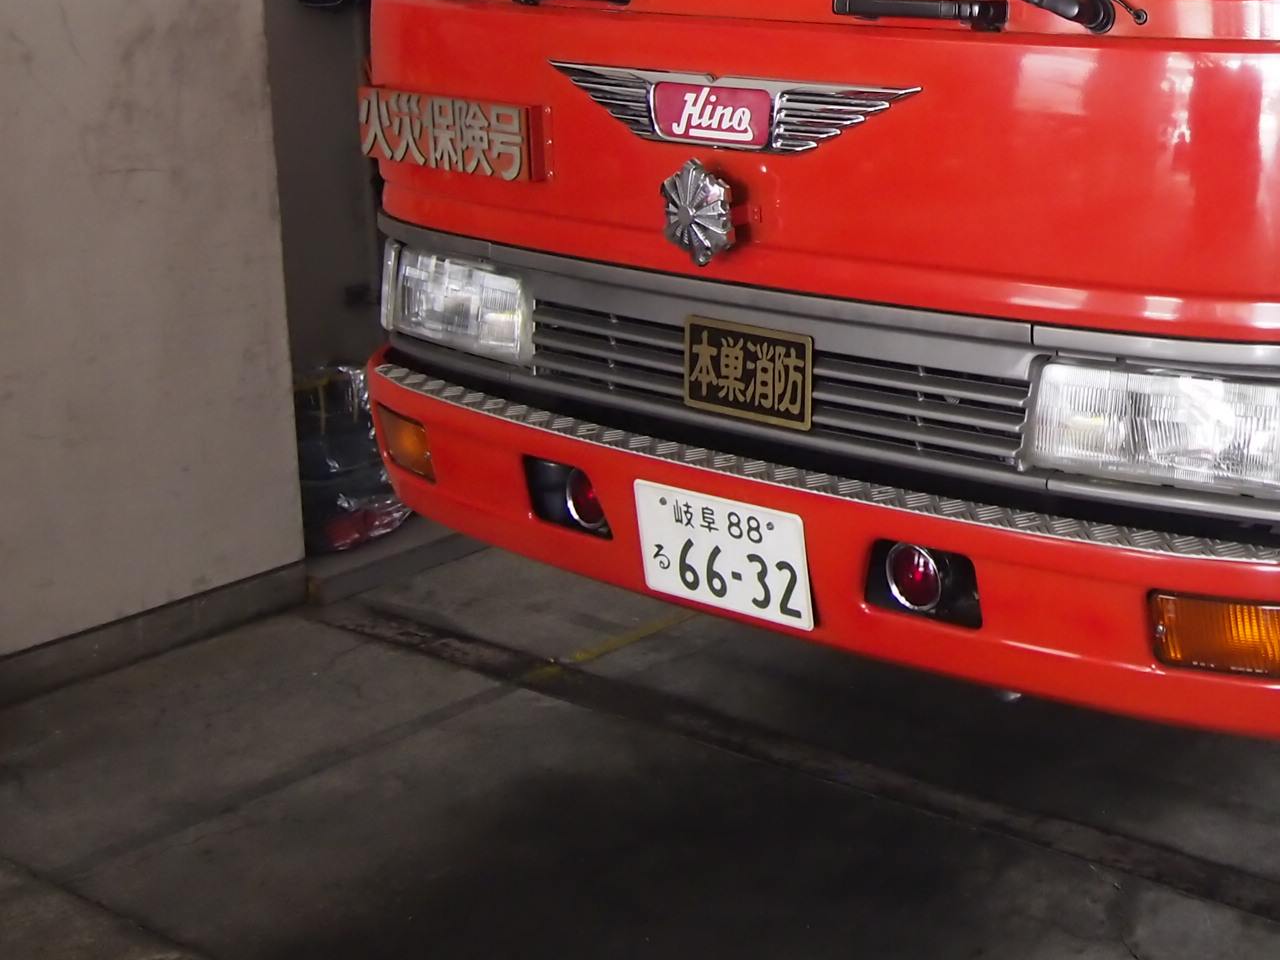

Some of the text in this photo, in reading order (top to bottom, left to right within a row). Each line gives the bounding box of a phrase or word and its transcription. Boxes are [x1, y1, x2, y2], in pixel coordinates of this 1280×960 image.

[359, 90, 523, 180] 火災保険号
[672, 87, 753, 139] Hino
[690, 330, 805, 415] 本巣消防
[673, 499, 763, 544] 岐阜 88
[653, 538, 802, 619] る 66-32
